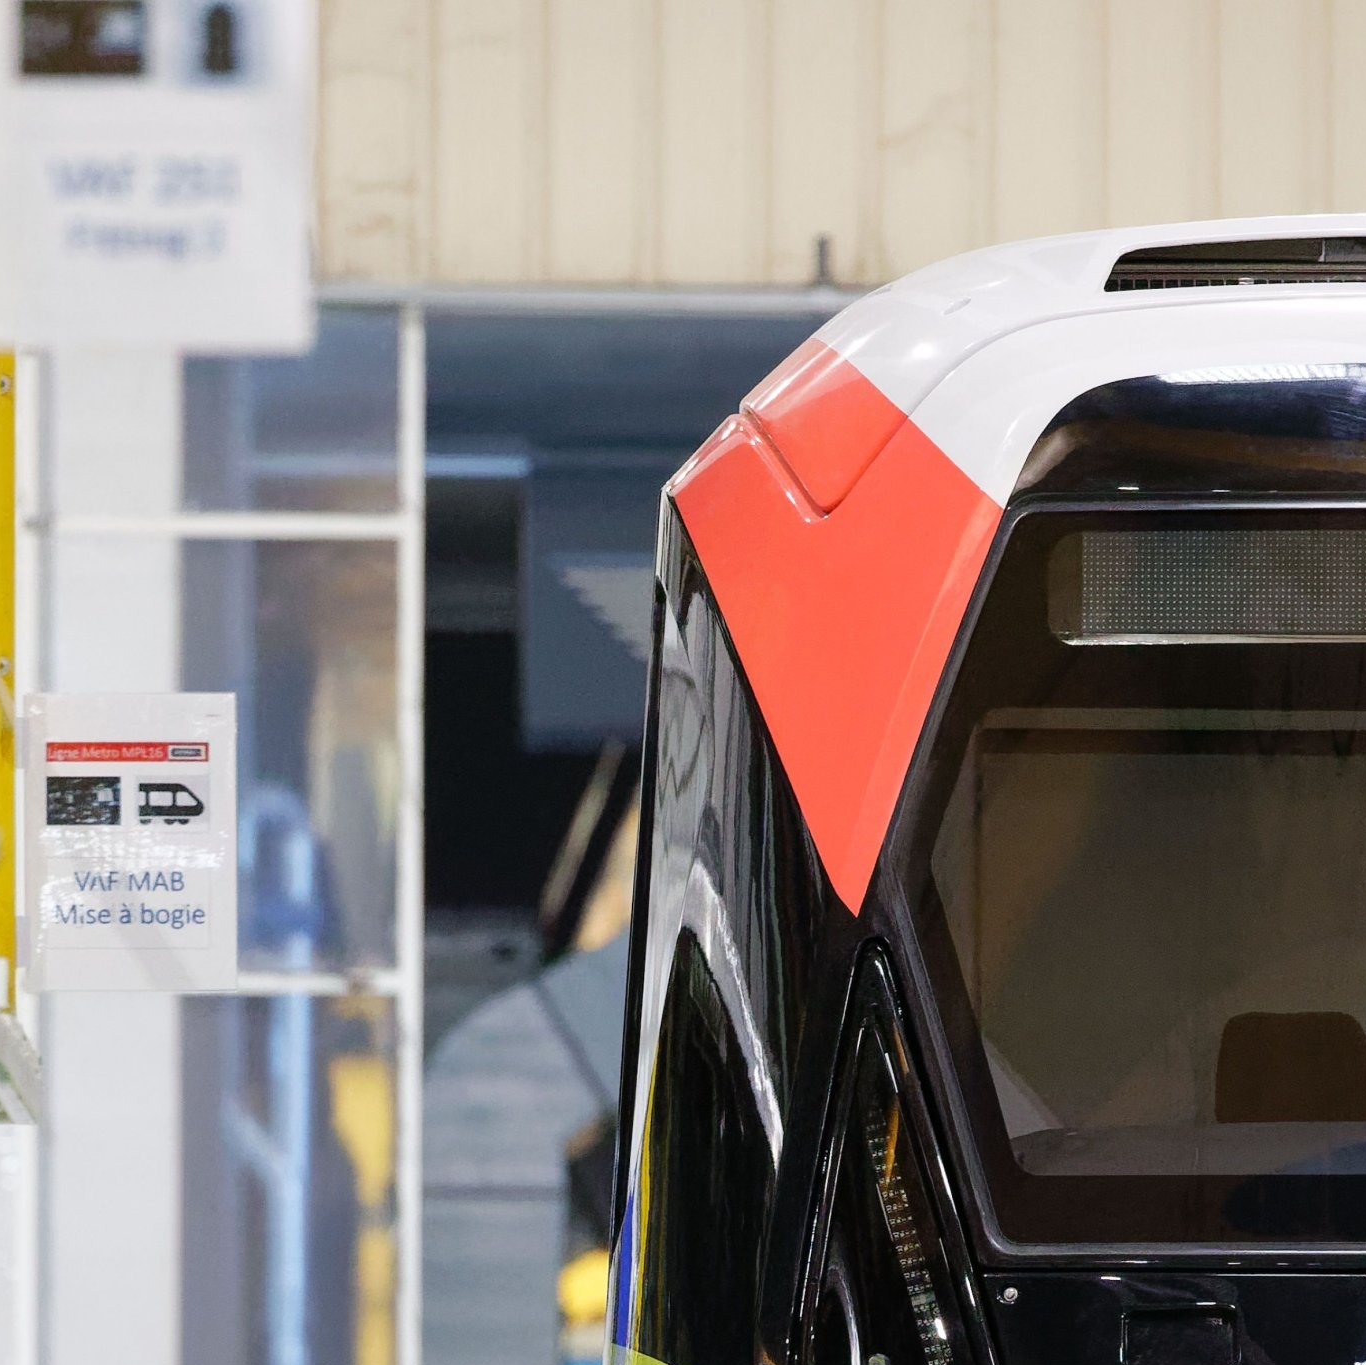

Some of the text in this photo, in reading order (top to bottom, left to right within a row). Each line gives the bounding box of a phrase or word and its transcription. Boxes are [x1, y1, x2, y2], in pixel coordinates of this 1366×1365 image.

[73, 871, 185, 892] VAF MAB
[55, 903, 206, 930] Mise à bogie
